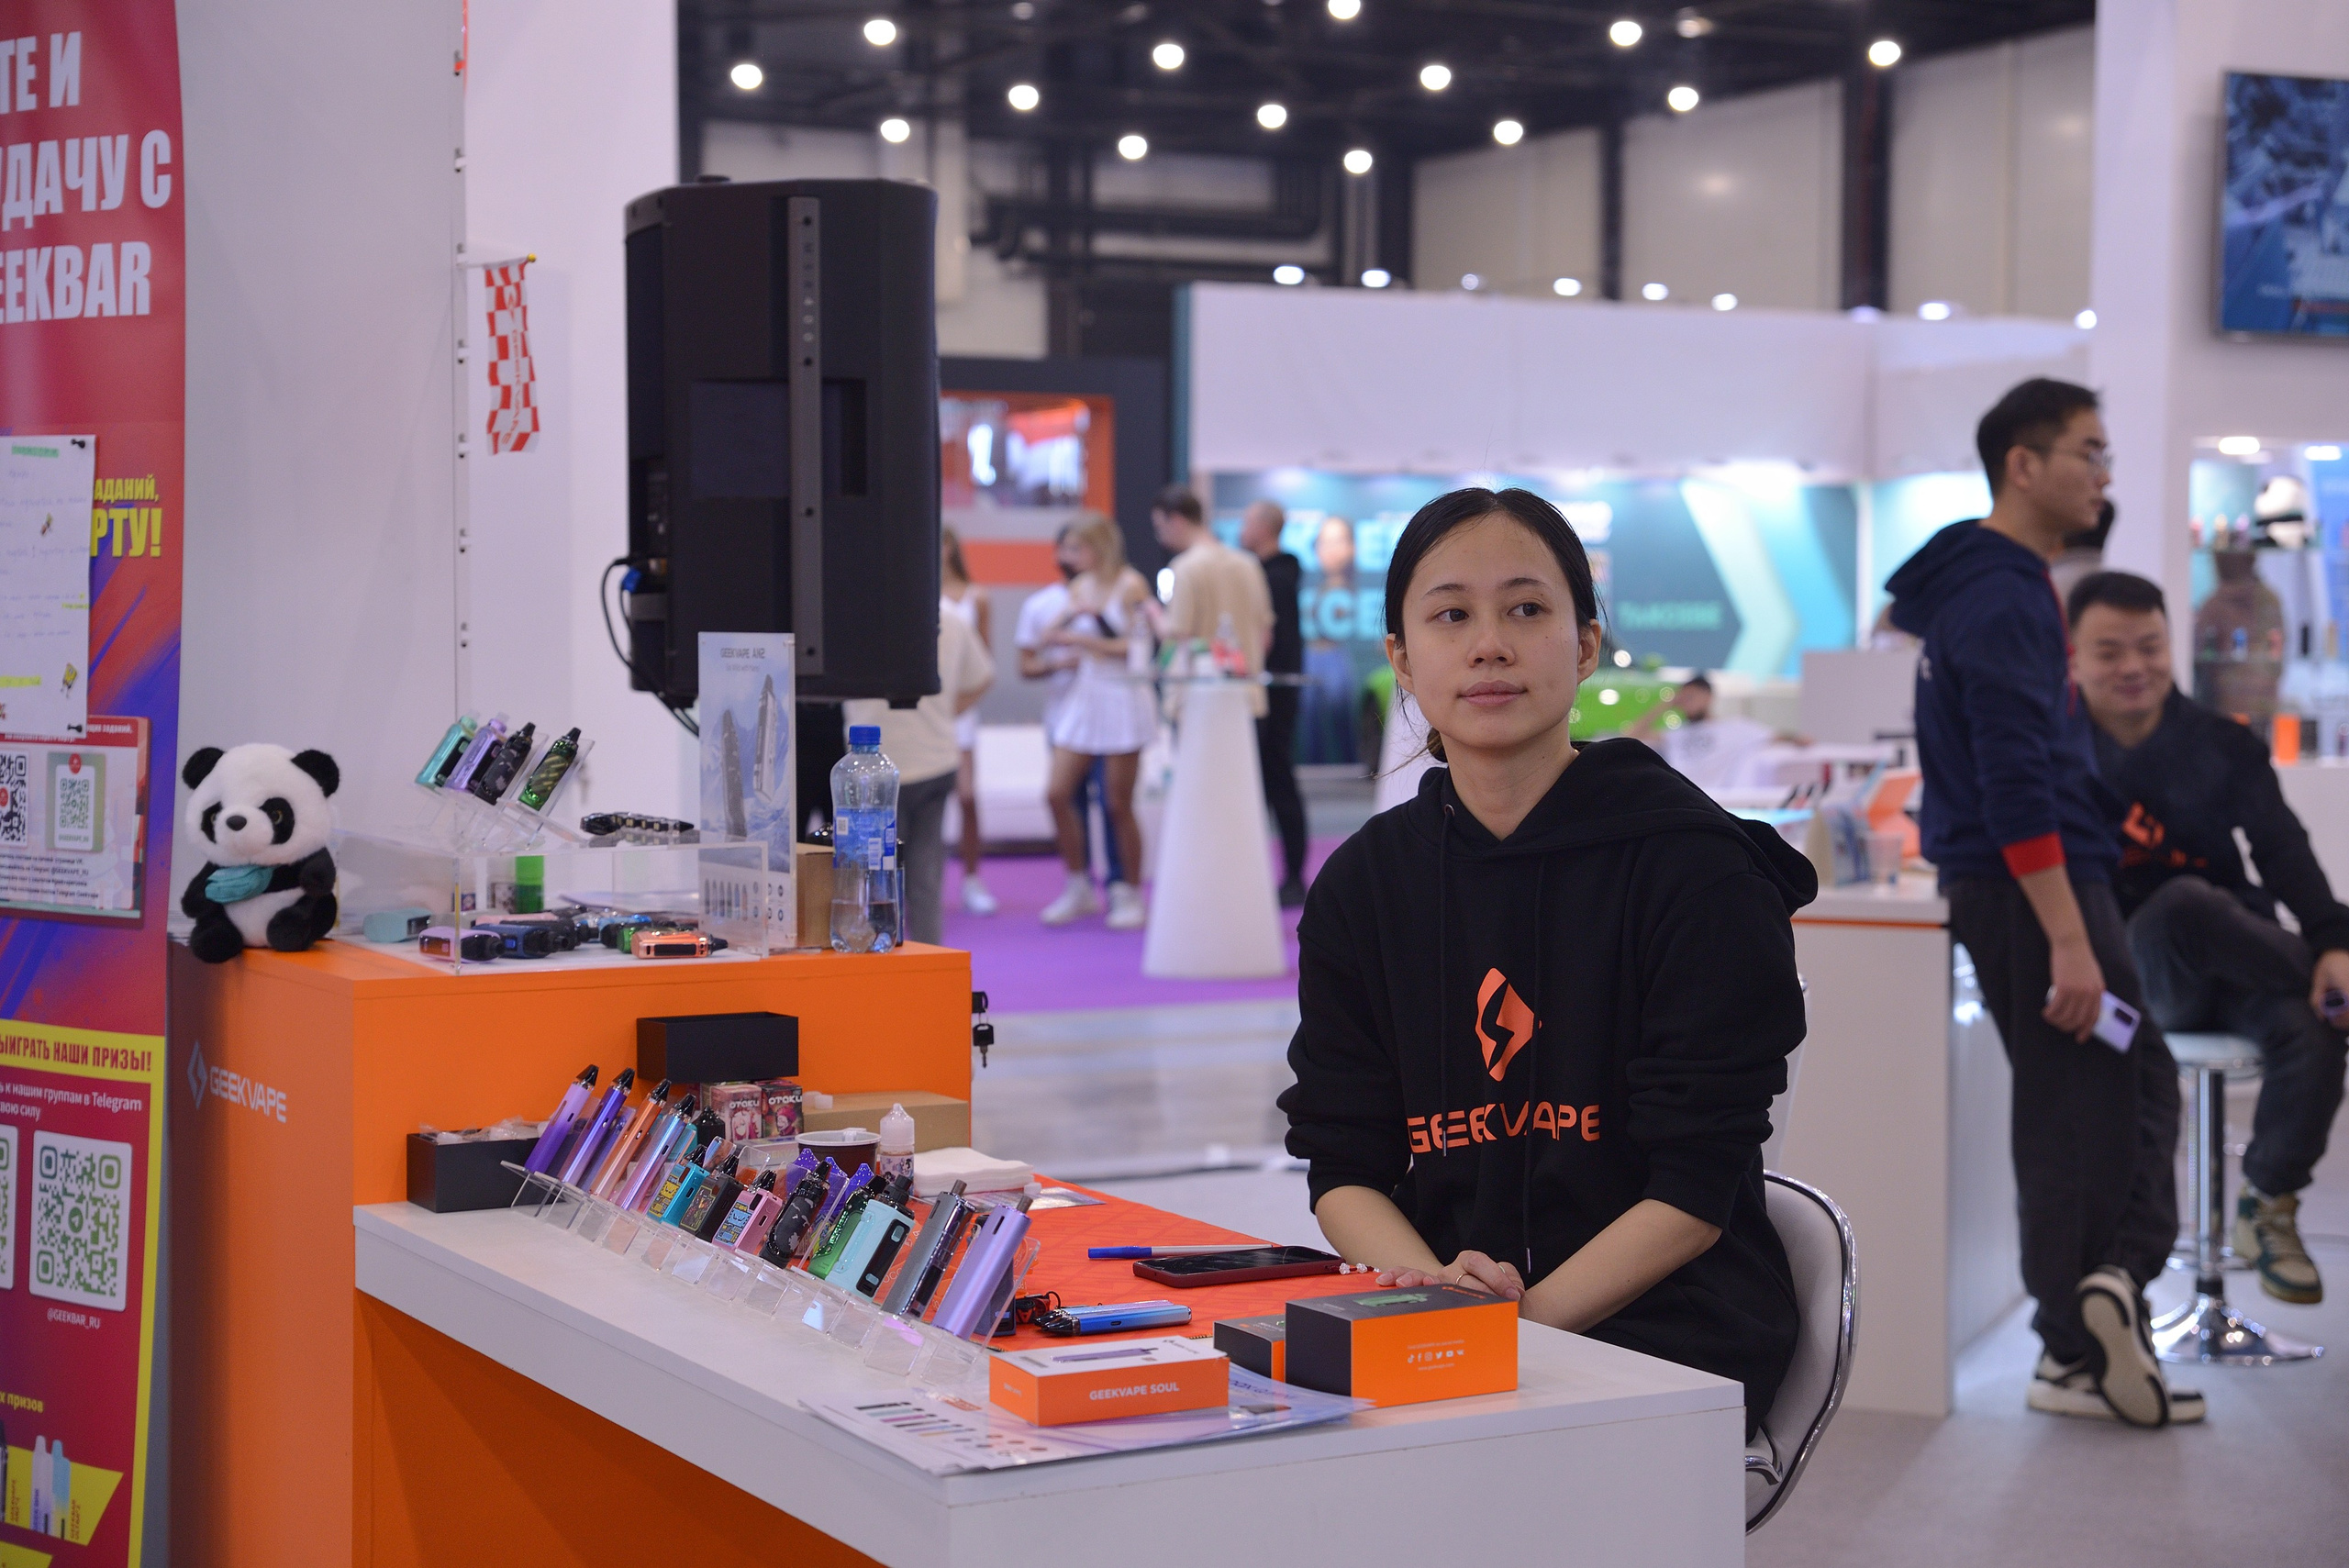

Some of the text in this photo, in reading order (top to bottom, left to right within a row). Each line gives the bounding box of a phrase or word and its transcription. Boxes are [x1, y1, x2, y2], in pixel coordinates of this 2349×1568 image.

[50, 30, 82, 108] И
[0, 128, 173, 232] ДАЧУ С
[0, 240, 151, 324] EKBAR
[95, 473, 159, 504] АДАНИЙ,
[90, 507, 162, 558] РТУ!
[53, 1041, 89, 1066] НАШИ
[93, 1046, 152, 1073] ПРИЗЫ!
[6, 1083, 11, 1095] к
[12, 1083, 42, 1099] нашим
[43, 1087, 82, 1106] группам
[83, 1093, 90, 1106] в
[92, 1091, 142, 1114] Telegram
[209, 1065, 287, 1124] GEEKVAPE
[729, 1098, 760, 1109] OTAKU
[768, 1095, 802, 1106] OTAKU
[20, 1104, 41, 1122] силу
[1407, 1101, 1600, 1153] GEEKVAPE
[47, 1307, 101, 1330] @GEEKBAR_RU
[7, 1393, 43, 1414] призов
[1089, 1382, 1180, 1401] GEEKVAPE SOUL
